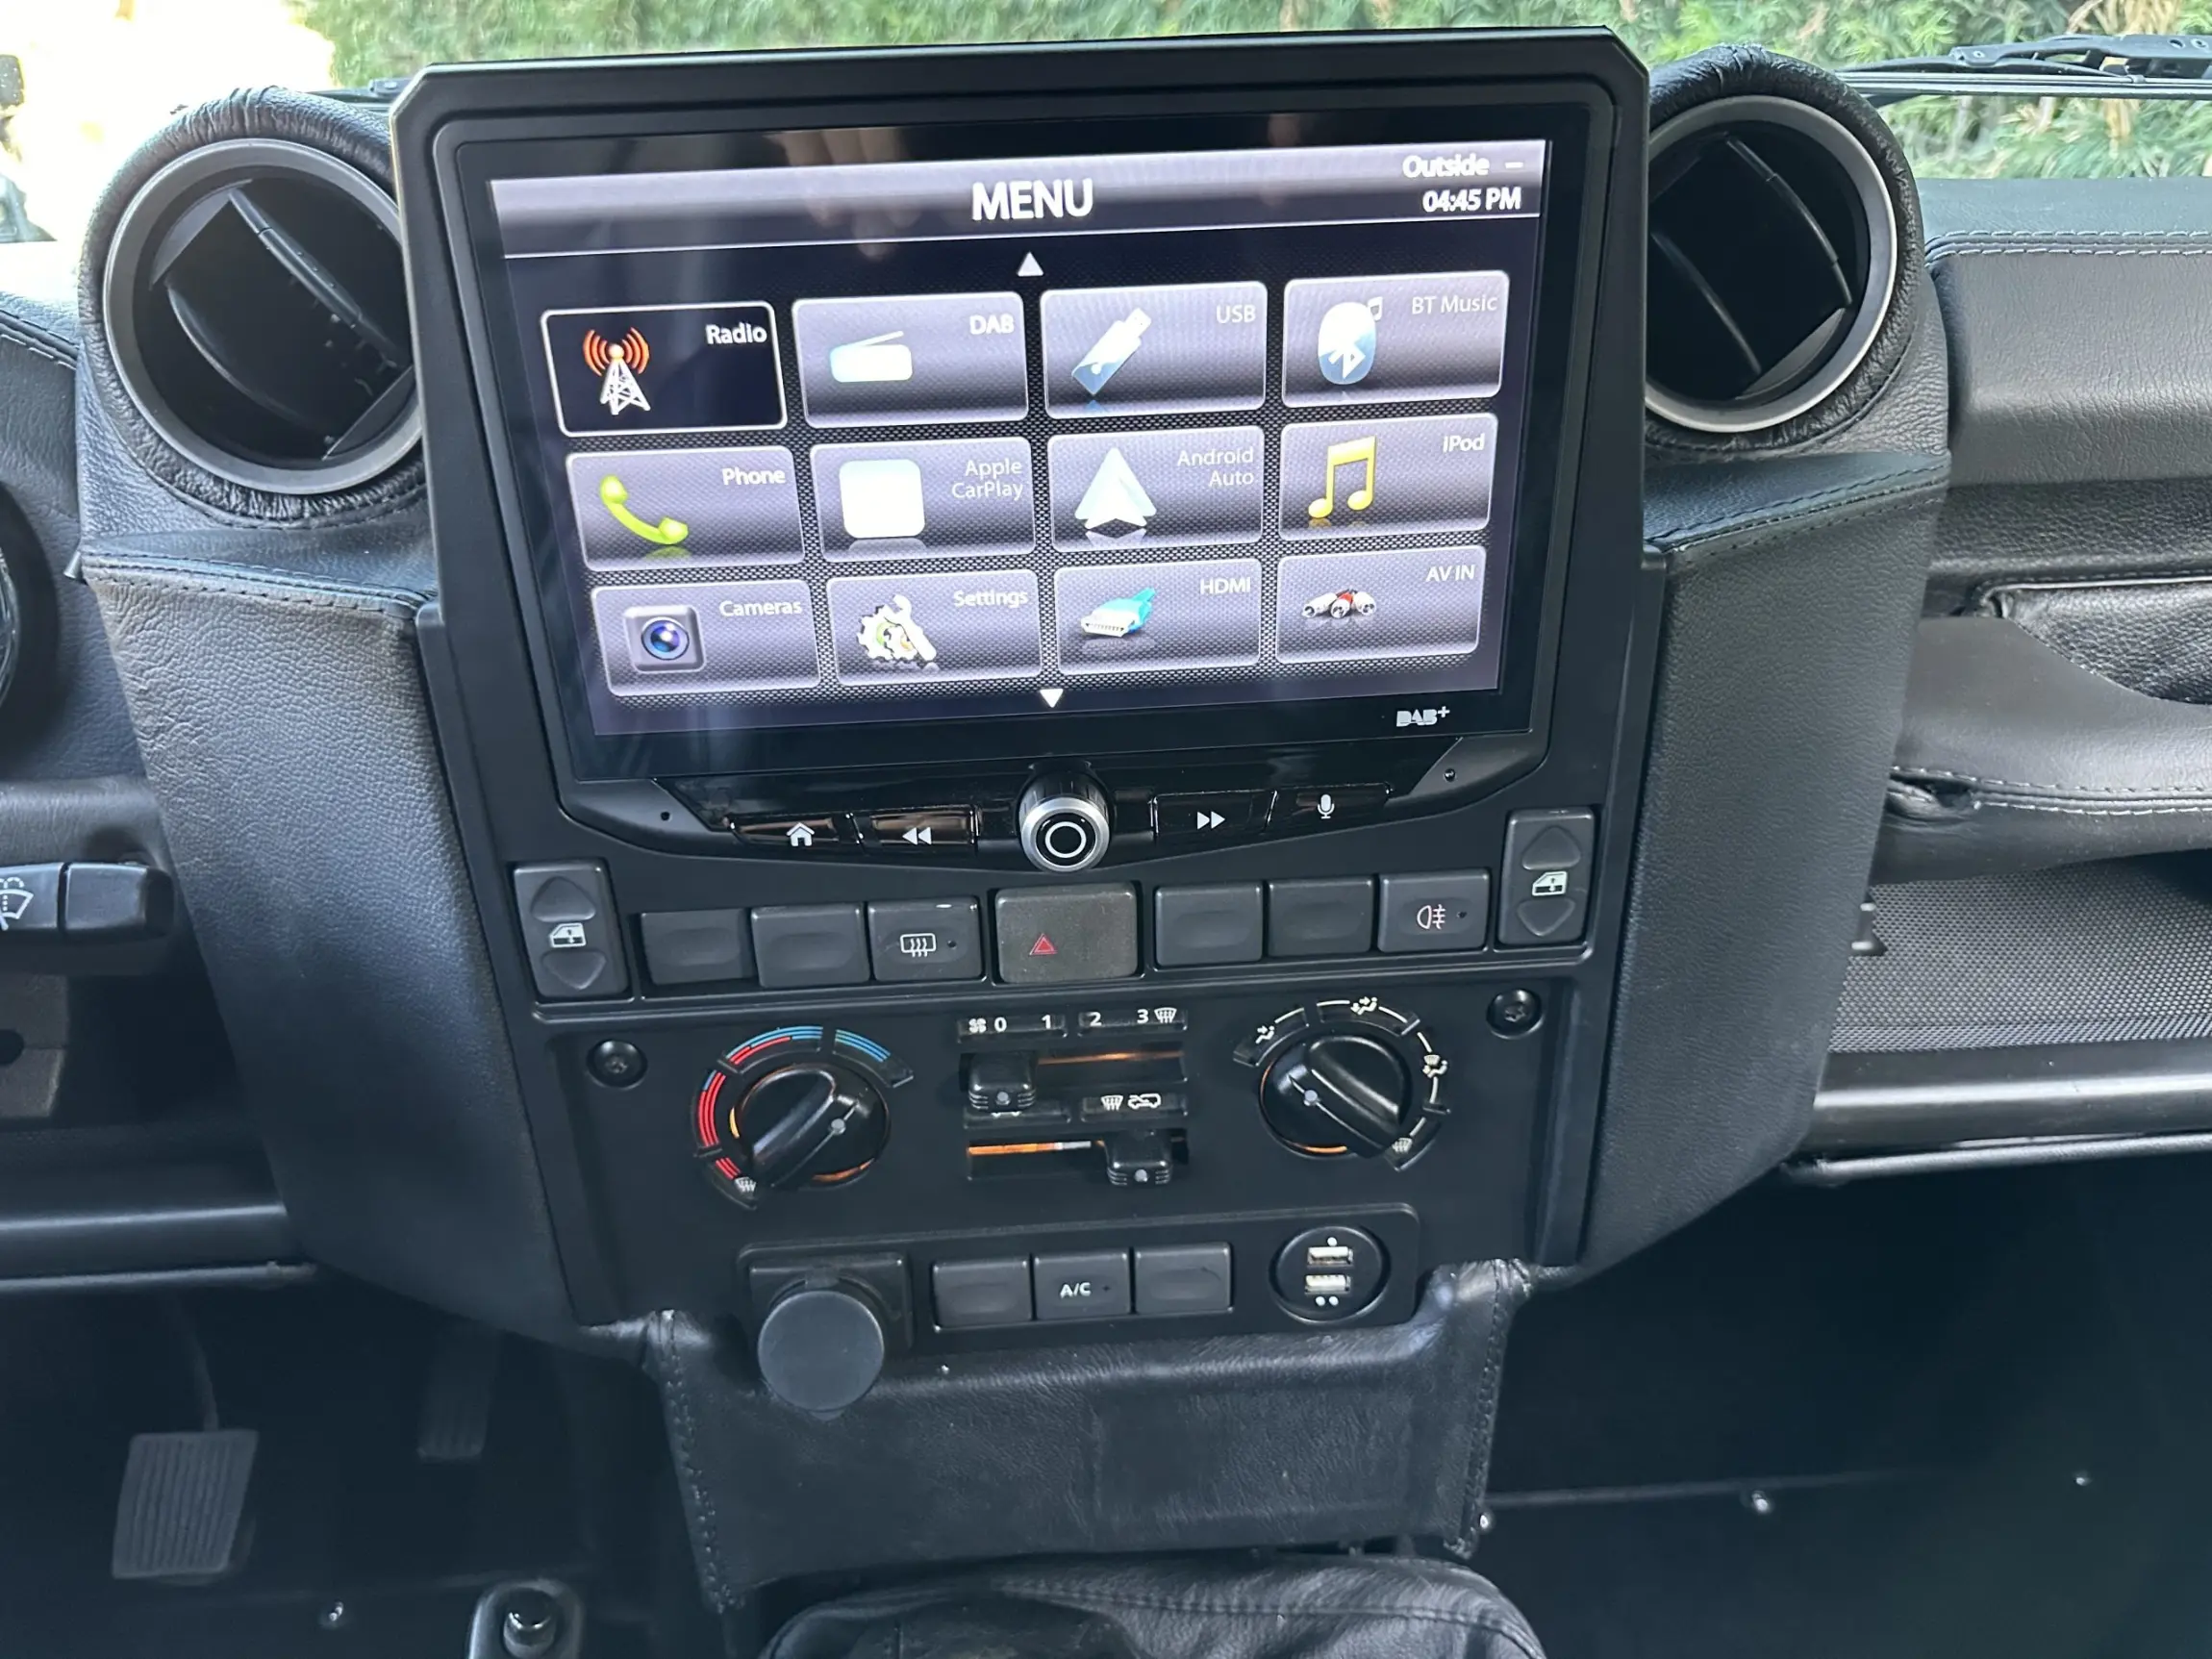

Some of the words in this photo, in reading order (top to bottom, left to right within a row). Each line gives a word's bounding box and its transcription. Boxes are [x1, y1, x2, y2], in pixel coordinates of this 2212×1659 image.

[1401, 155, 1490, 177] Outside
[971, 179, 1093, 221] MENU
[1422, 189, 1480, 213] 04:45
[1486, 187, 1521, 210] PM
[1216, 304, 1256, 324] USB
[1411, 295, 1436, 314] BT
[1440, 294, 1497, 314] Music
[705, 322, 767, 344] Radio
[969, 314, 1015, 335] DAB
[1443, 433, 1485, 452] iPod
[1176, 447, 1254, 467] Android
[721, 466, 786, 486] Phone
[965, 457, 1022, 480] Apple
[1208, 469, 1254, 488] Auto
[951, 479, 1023, 501] CarPlay
[1425, 566, 1452, 583] AV
[1453, 565, 1475, 581] IN
[1199, 576, 1251, 595] HDMI
[718, 599, 802, 618] Cameras
[953, 589, 1028, 610] Settings
[993, 1017, 1008, 1033] 0
[1041, 1014, 1052, 1030] 1
[1089, 1011, 1102, 1026] 2
[1136, 1008, 1149, 1024] 3
[1059, 1282, 1091, 1299] A/C
